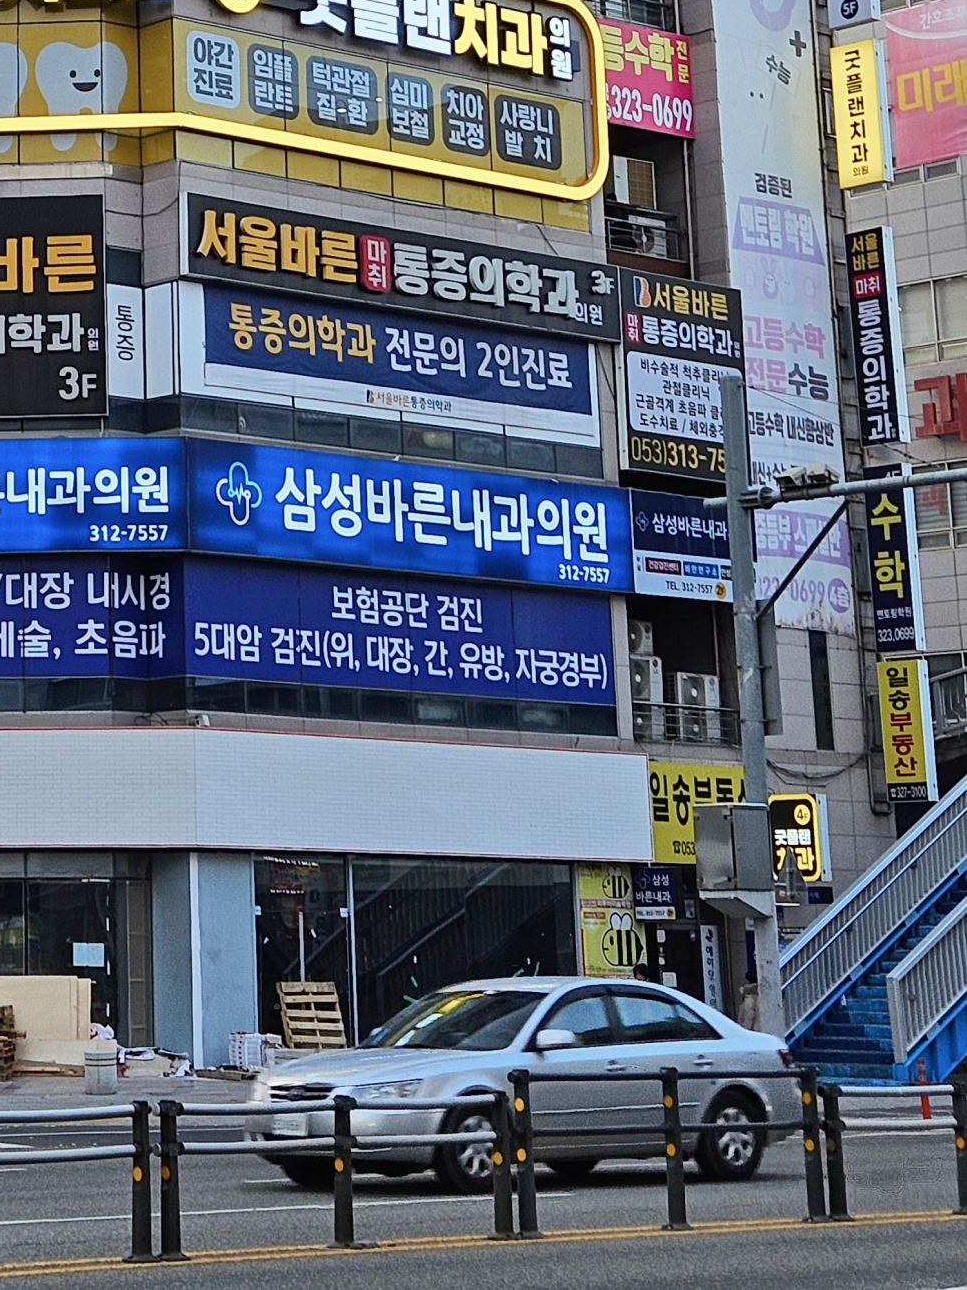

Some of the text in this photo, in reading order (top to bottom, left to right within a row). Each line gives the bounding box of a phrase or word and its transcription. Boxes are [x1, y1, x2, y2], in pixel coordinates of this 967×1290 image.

[841, 1, 858, 17] 5F
[193, 35, 235, 67] 야간
[676, 40, 690, 84] 전문
[193, 67, 235, 101] 진료
[312, 61, 371, 99] 턱관절
[765, 54, 792, 86] 수능
[390, 77, 429, 110] 심미
[446, 88, 484, 122] 치아
[611, 84, 694, 132] 323-0699
[844, 48, 869, 165] 굿플랜치과
[392, 109, 430, 140] 보철
[500, 99, 555, 134] 사랑니
[448, 118, 484, 150] 교정
[755, 173, 793, 199] 검증된
[852, 164, 869, 177] 의원
[851, 233, 878, 254] 서울
[196, 209, 603, 327] 서울바른 통증의학과 의원
[852, 249, 880, 272] 바른
[590, 270, 615, 296] 3F
[855, 277, 881, 295] 마취
[653, 282, 729, 321] 서울바른
[87, 326, 100, 351] 의원
[229, 302, 574, 392] 통증의학과 전문의 2인진료
[626, 312, 733, 357] 마취 통증의학과
[743, 314, 826, 360] 고등수학
[57, 366, 98, 400] 3F
[640, 358, 679, 378] 비수술적
[857, 299, 893, 443] 통증의학과
[635, 394, 707, 419] 근골격계 초음파
[662, 380, 710, 401] 관절클리닉
[640, 413, 679, 433] 도수치료
[275, 466, 610, 564] 삼성바른내과의원
[652, 512, 728, 542] 삼성바른내과
[89, 524, 169, 543] 312-7557
[871, 493, 906, 599] 수학
[558, 563, 611, 584] 312-7557
[666, 580, 713, 594] TEL. 312-7557
[87, 571, 171, 611] 내시경
[331, 586, 484, 634] 보험공단 검진
[75, 619, 166, 659] 초음파
[193, 621, 609, 690] 5대암 자궁경부)
[885, 666, 918, 779] 일송부동산
[797, 808, 809, 822] 4F
[774, 829, 811, 846] 굿플랜
[652, 873, 669, 886] 삼성
[635, 890, 671, 904] 바른내과
